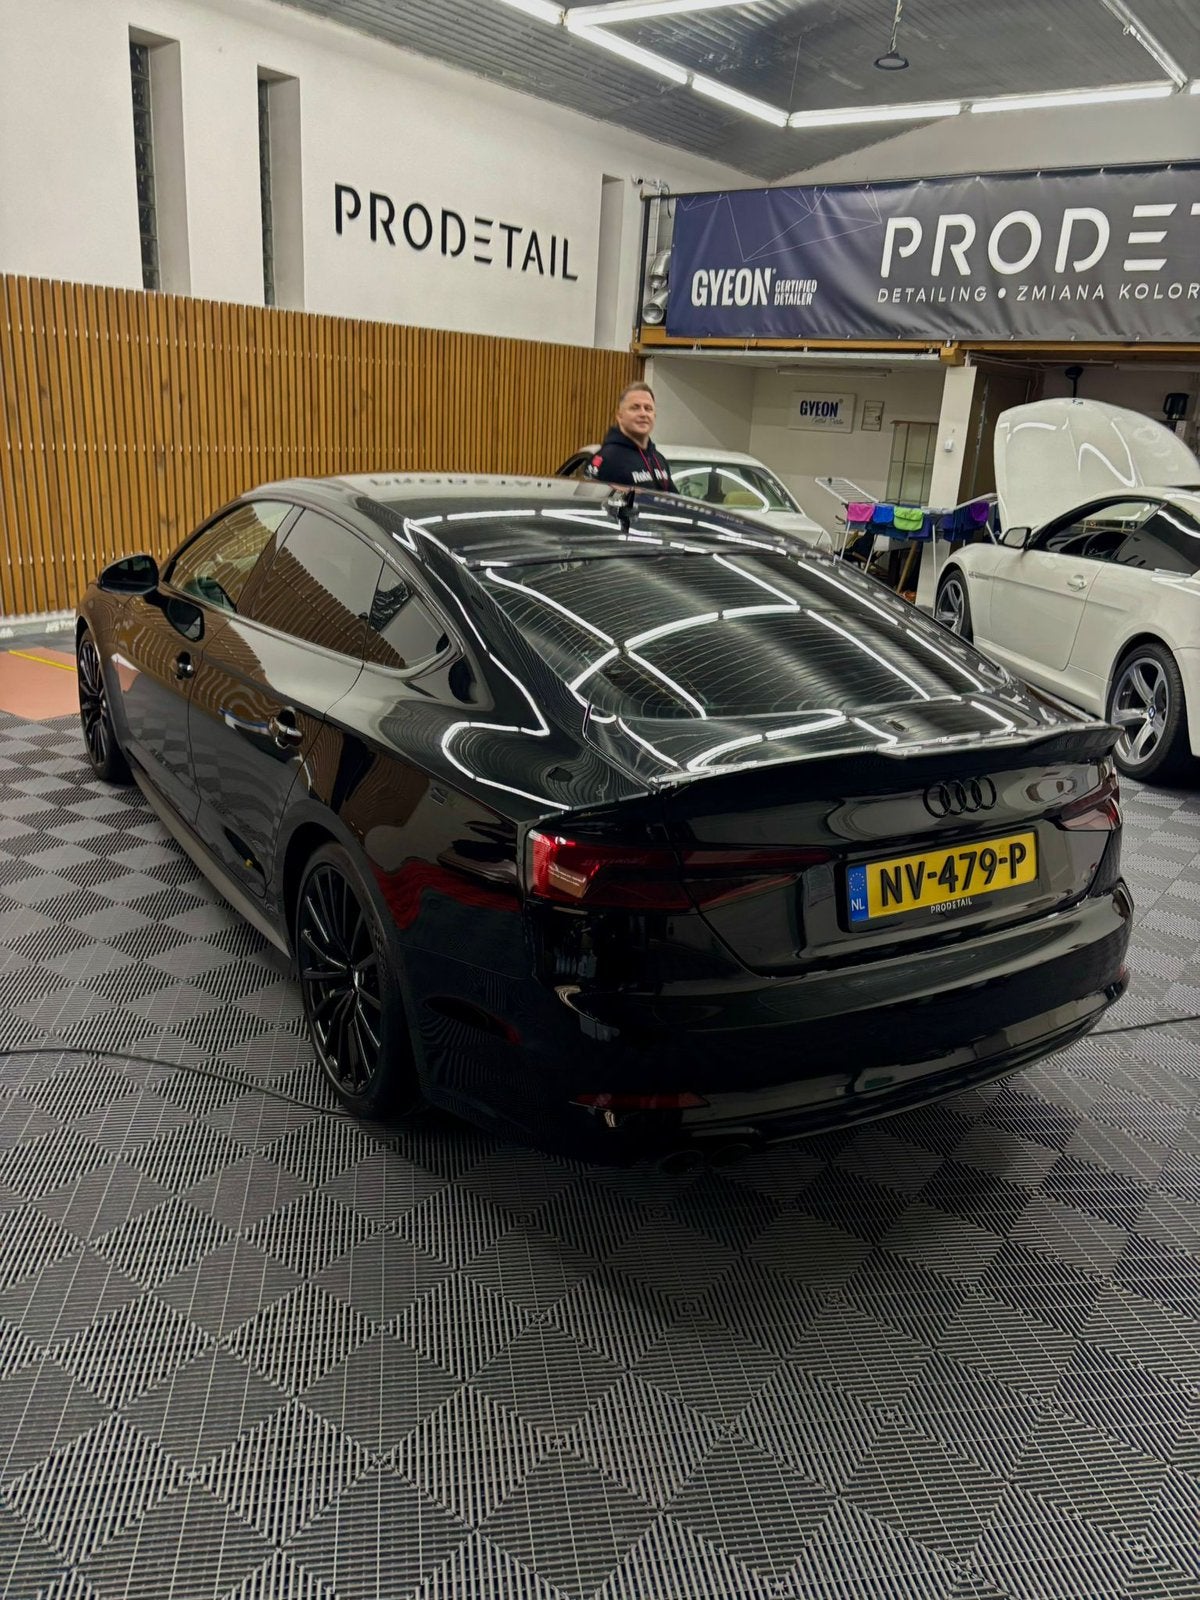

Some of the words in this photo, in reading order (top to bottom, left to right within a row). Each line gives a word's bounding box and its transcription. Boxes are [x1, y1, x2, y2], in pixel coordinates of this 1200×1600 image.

[334, 182, 578, 281] PRODETAIL
[691, 267, 772, 307] GYEON
[774, 279, 818, 293] CERTIFIED
[877, 286, 987, 303] DETAILING
[1016, 284, 1105, 301] ZMIANA
[1118, 282, 1200, 300] KOLOR
[773, 292, 813, 306] DETAILER
[800, 400, 839, 417] GYEON
[880, 842, 1026, 907] NV-479-P
[851, 898, 865, 911] NL
[930, 897, 973, 914] PRODETAIL
